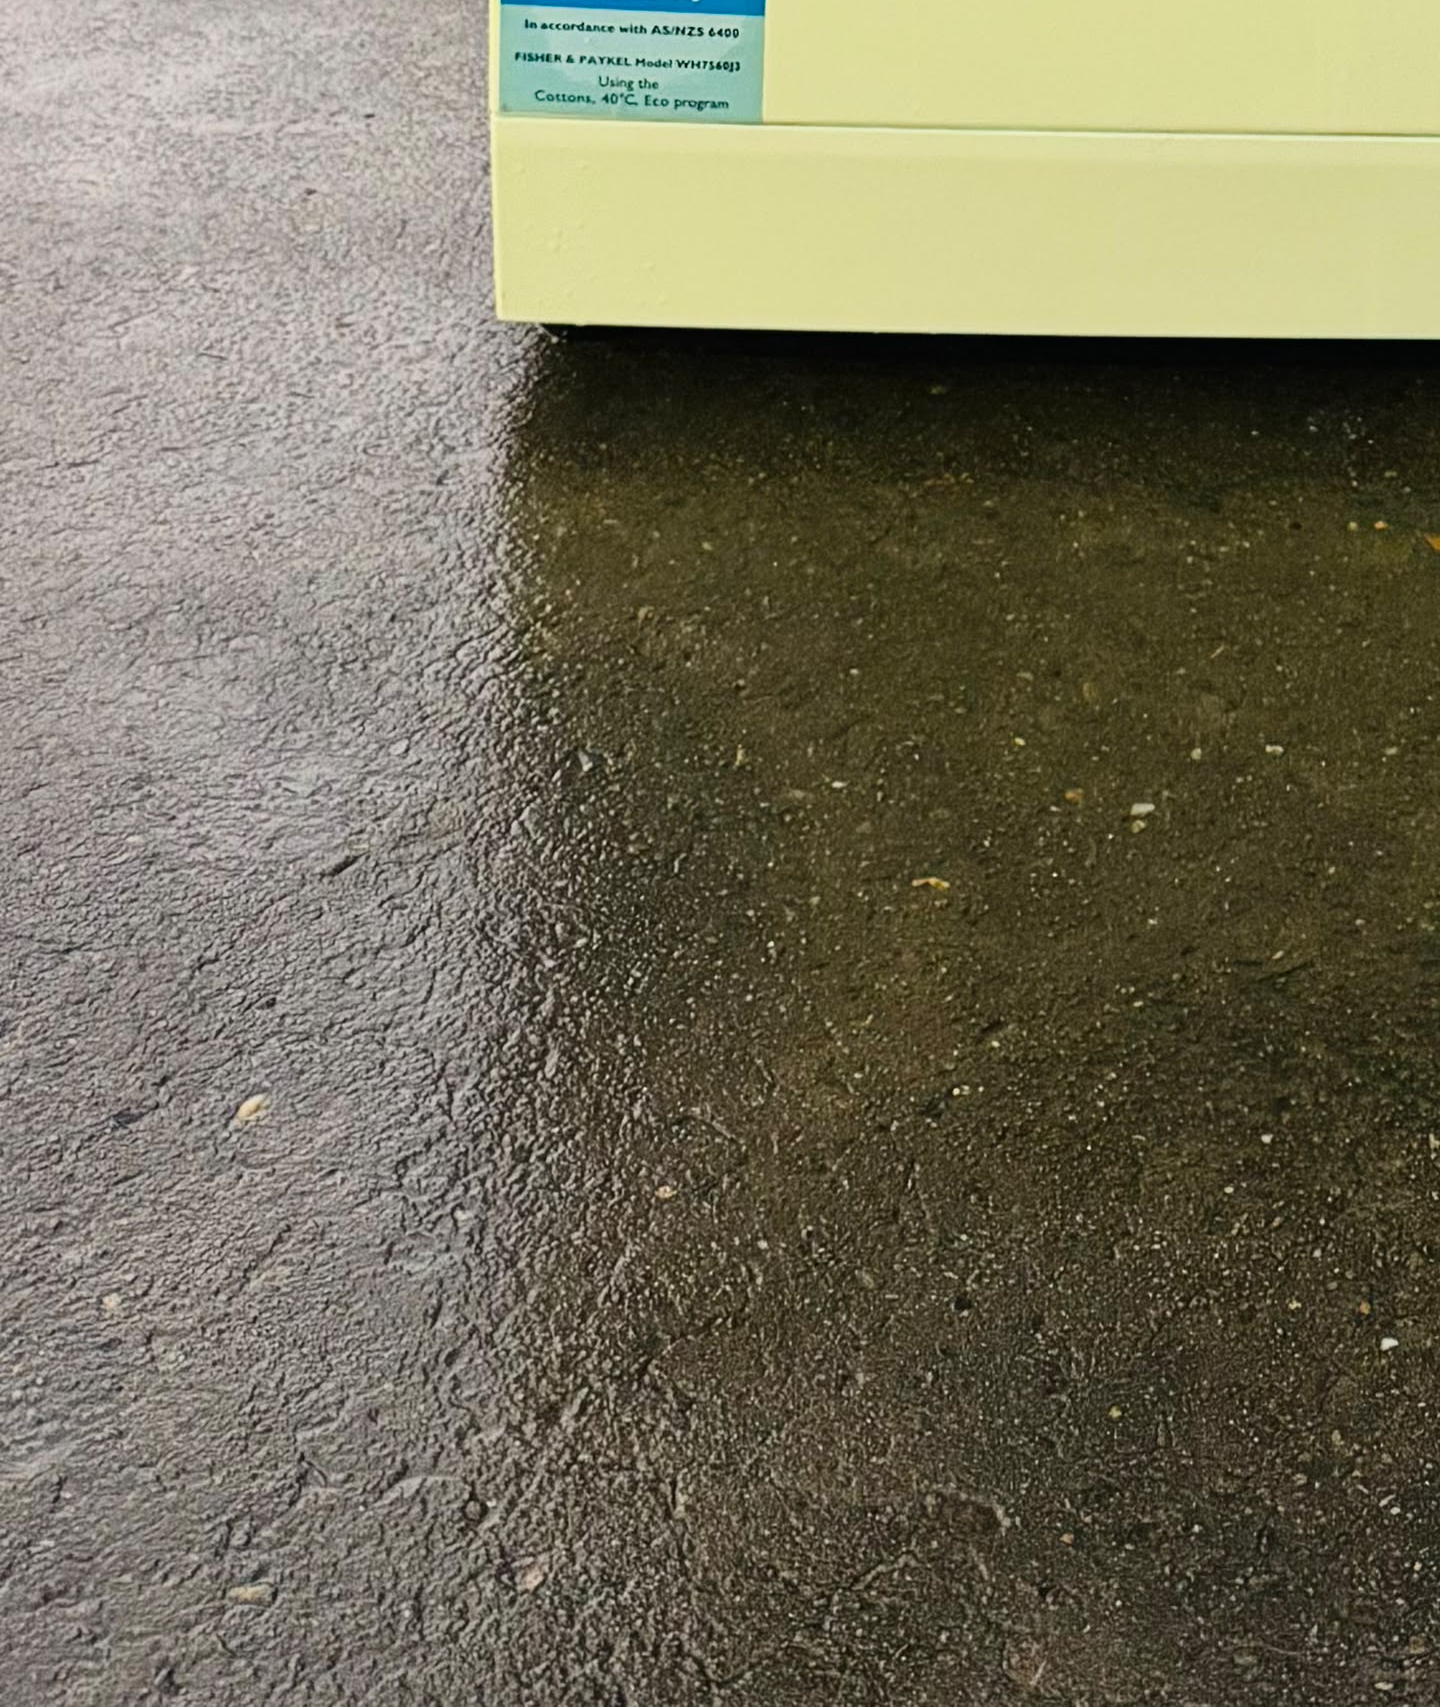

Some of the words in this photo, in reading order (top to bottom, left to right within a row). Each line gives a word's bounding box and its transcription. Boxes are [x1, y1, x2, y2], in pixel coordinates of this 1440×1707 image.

[524, 18, 538, 29] In
[541, 21, 616, 34] accordance
[619, 23, 647, 35] with
[651, 25, 705, 38] AS/NZS
[708, 27, 740, 39] 6400
[515, 51, 562, 63] FISHER
[566, 54, 575, 64] &
[579, 55, 632, 66] PAYKEL
[635, 58, 673, 69] Model
[598, 75, 635, 92] Using
[638, 78, 659, 90] the
[644, 94, 670, 107] Eco
[674, 98, 729, 112] program
